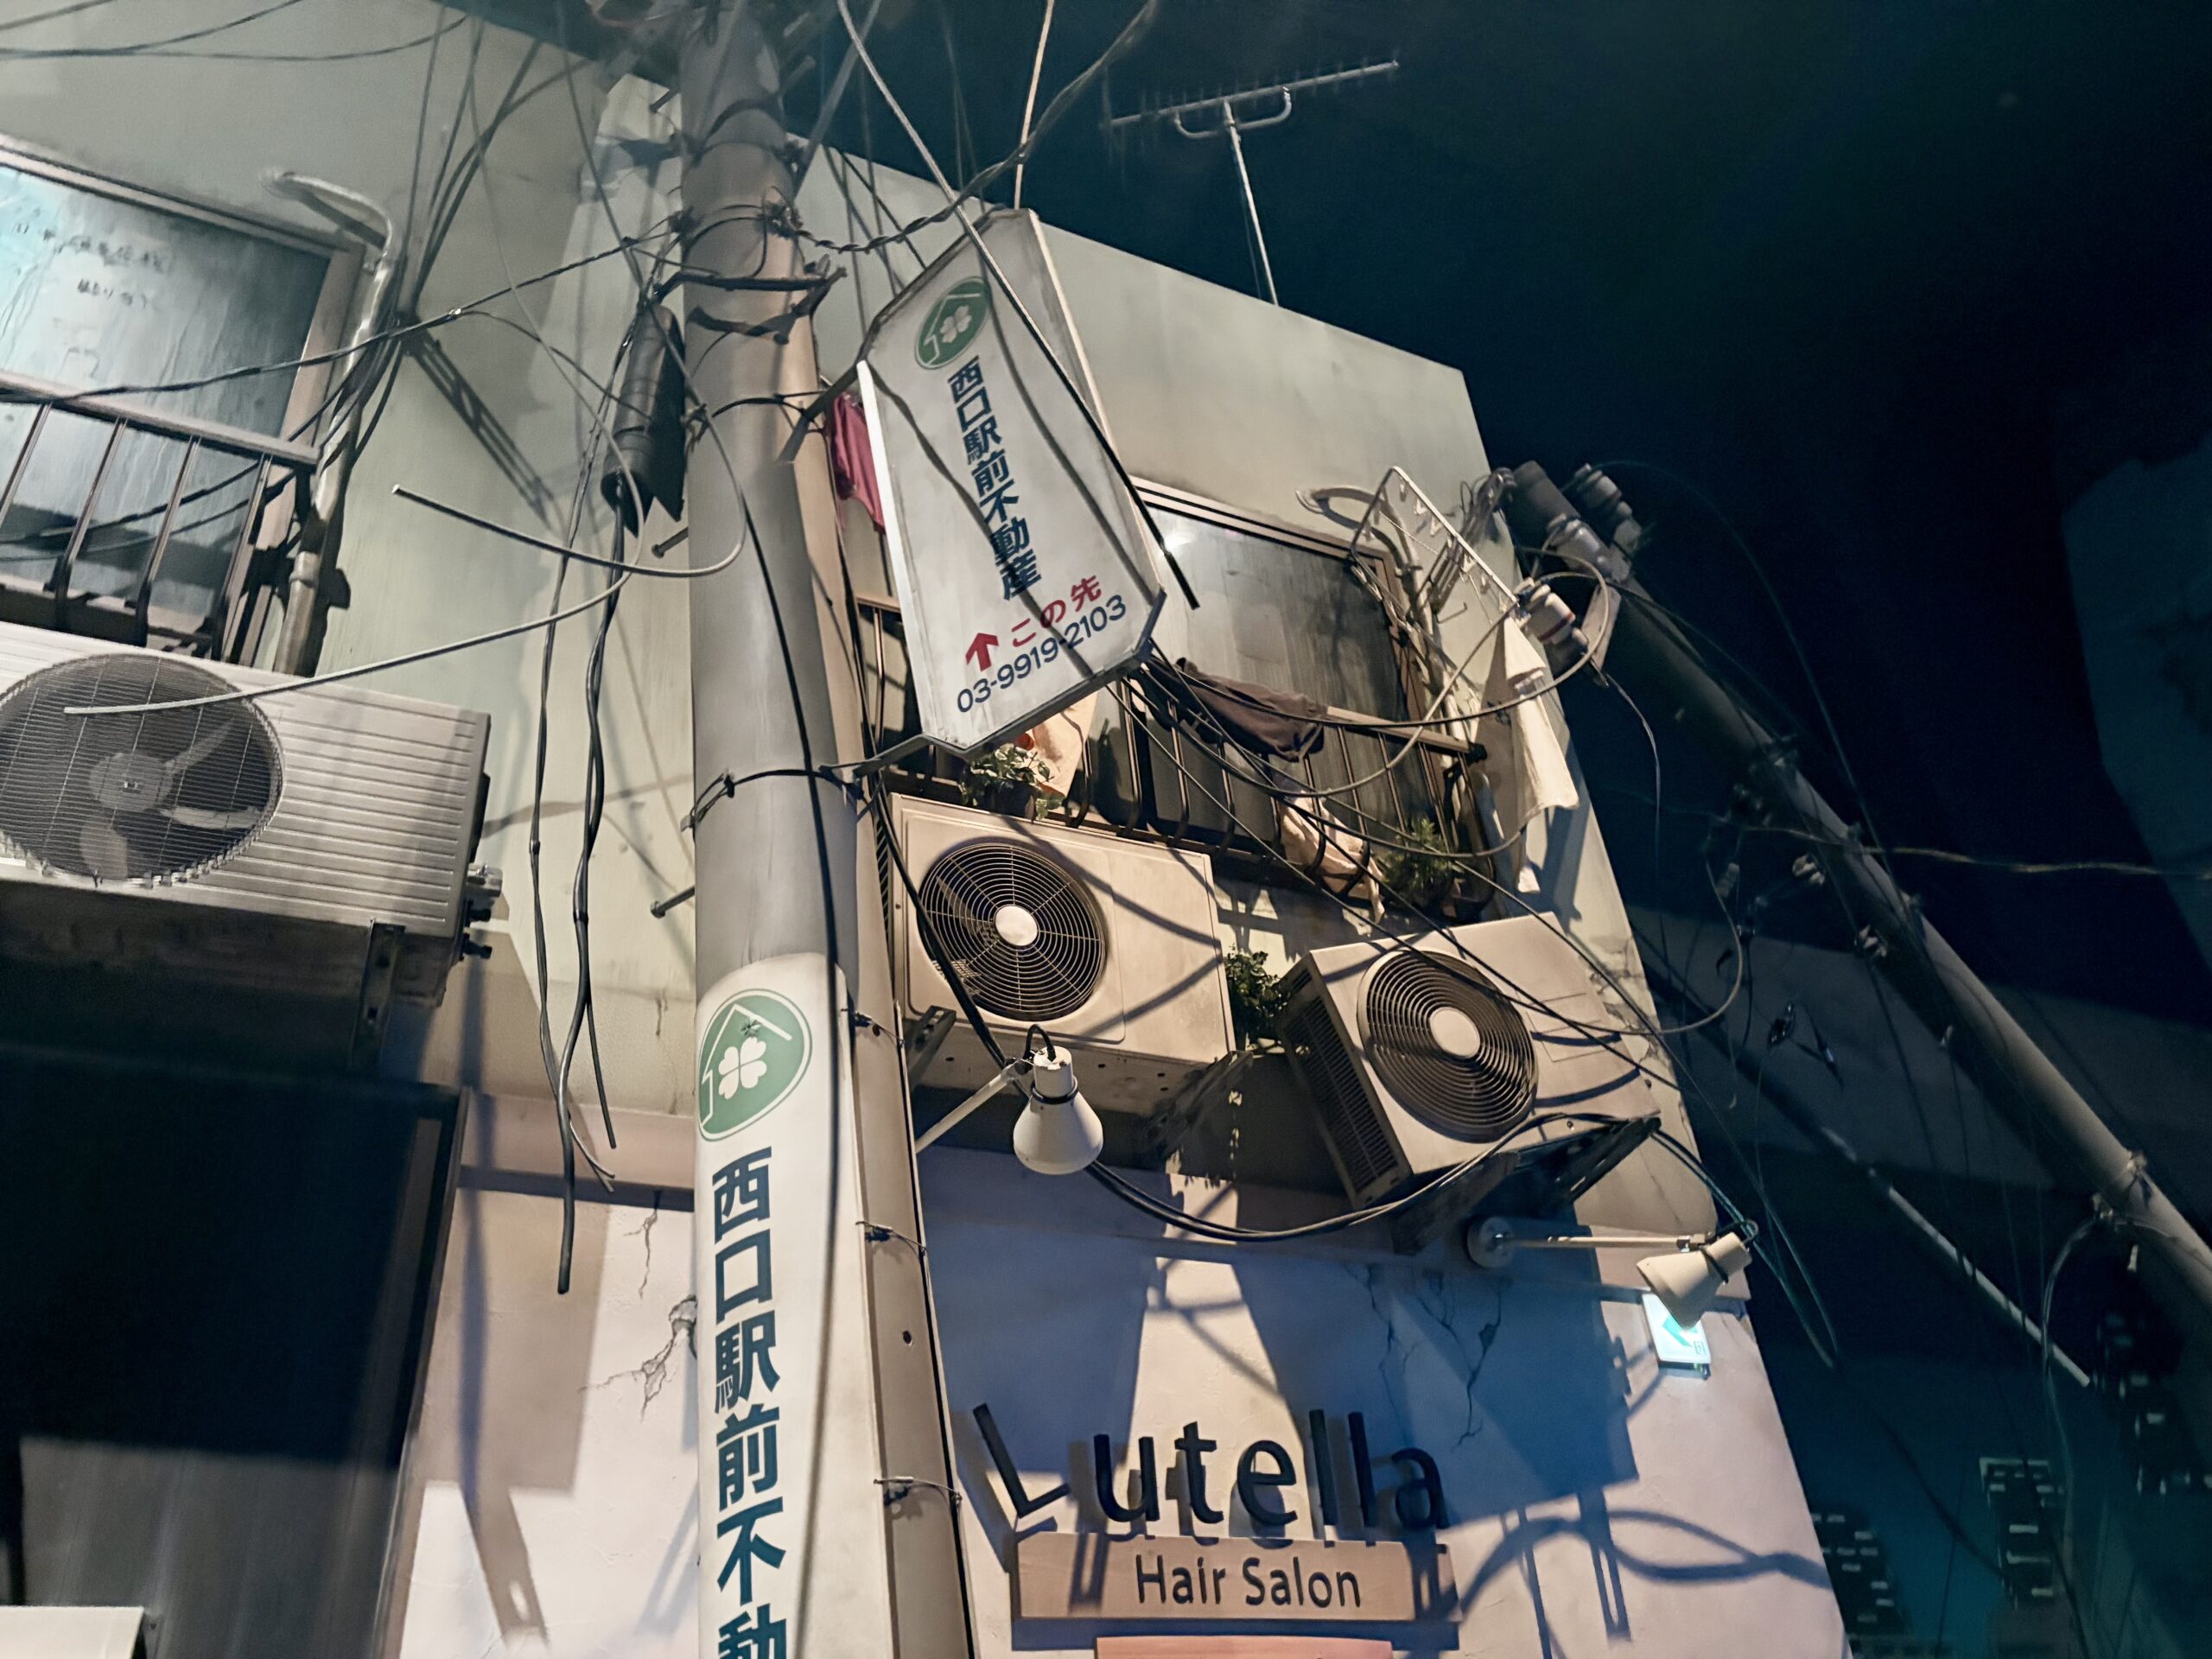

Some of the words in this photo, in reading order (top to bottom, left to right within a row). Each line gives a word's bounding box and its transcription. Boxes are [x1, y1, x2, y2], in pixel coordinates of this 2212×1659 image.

[947, 355, 1042, 601] 西口駅前不動産
[957, 594, 1127, 713] 03-9919-2103
[1011, 575, 1103, 648] この先
[972, 1403, 1450, 1529] Lutella
[1135, 1554, 1226, 1605] Hair
[1242, 1556, 1362, 1608] Salon
